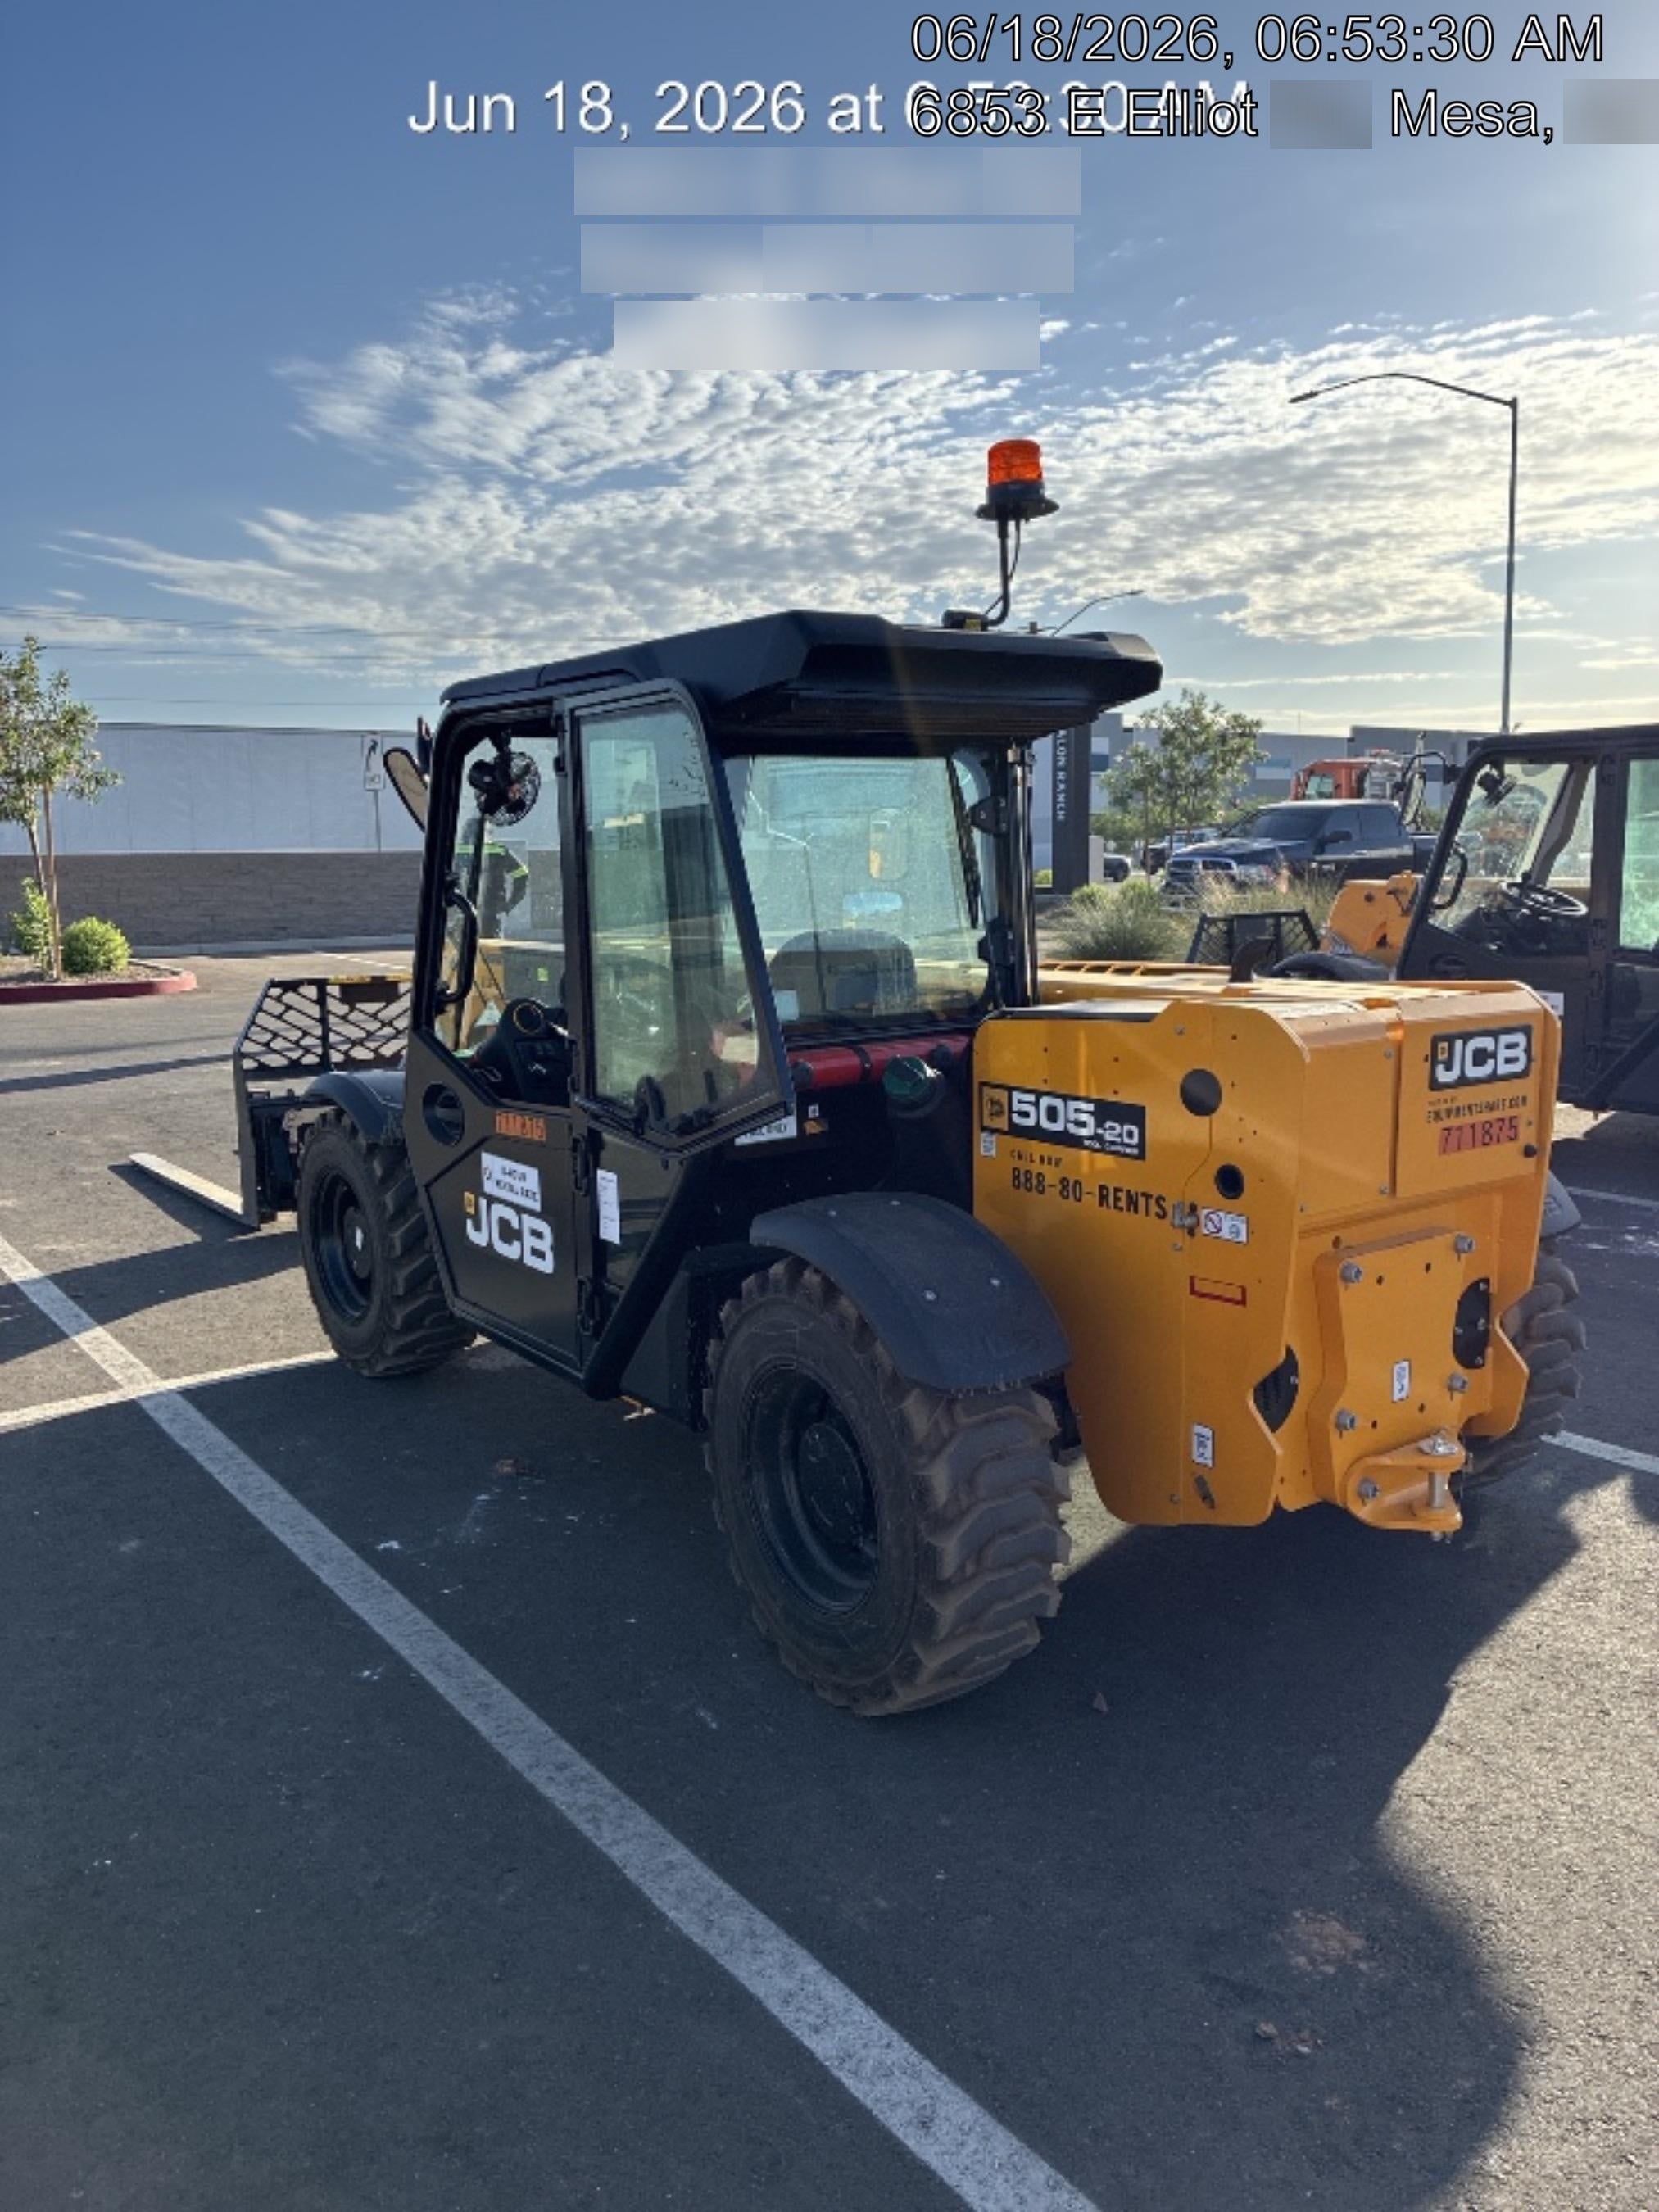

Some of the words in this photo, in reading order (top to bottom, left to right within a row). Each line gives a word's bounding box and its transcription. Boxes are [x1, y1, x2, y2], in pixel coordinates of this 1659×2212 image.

[1435, 1031, 1528, 1083] JCB
[1011, 1167, 1168, 1220] 888-80-RENTS
[465, 1196, 555, 1275] JCB
